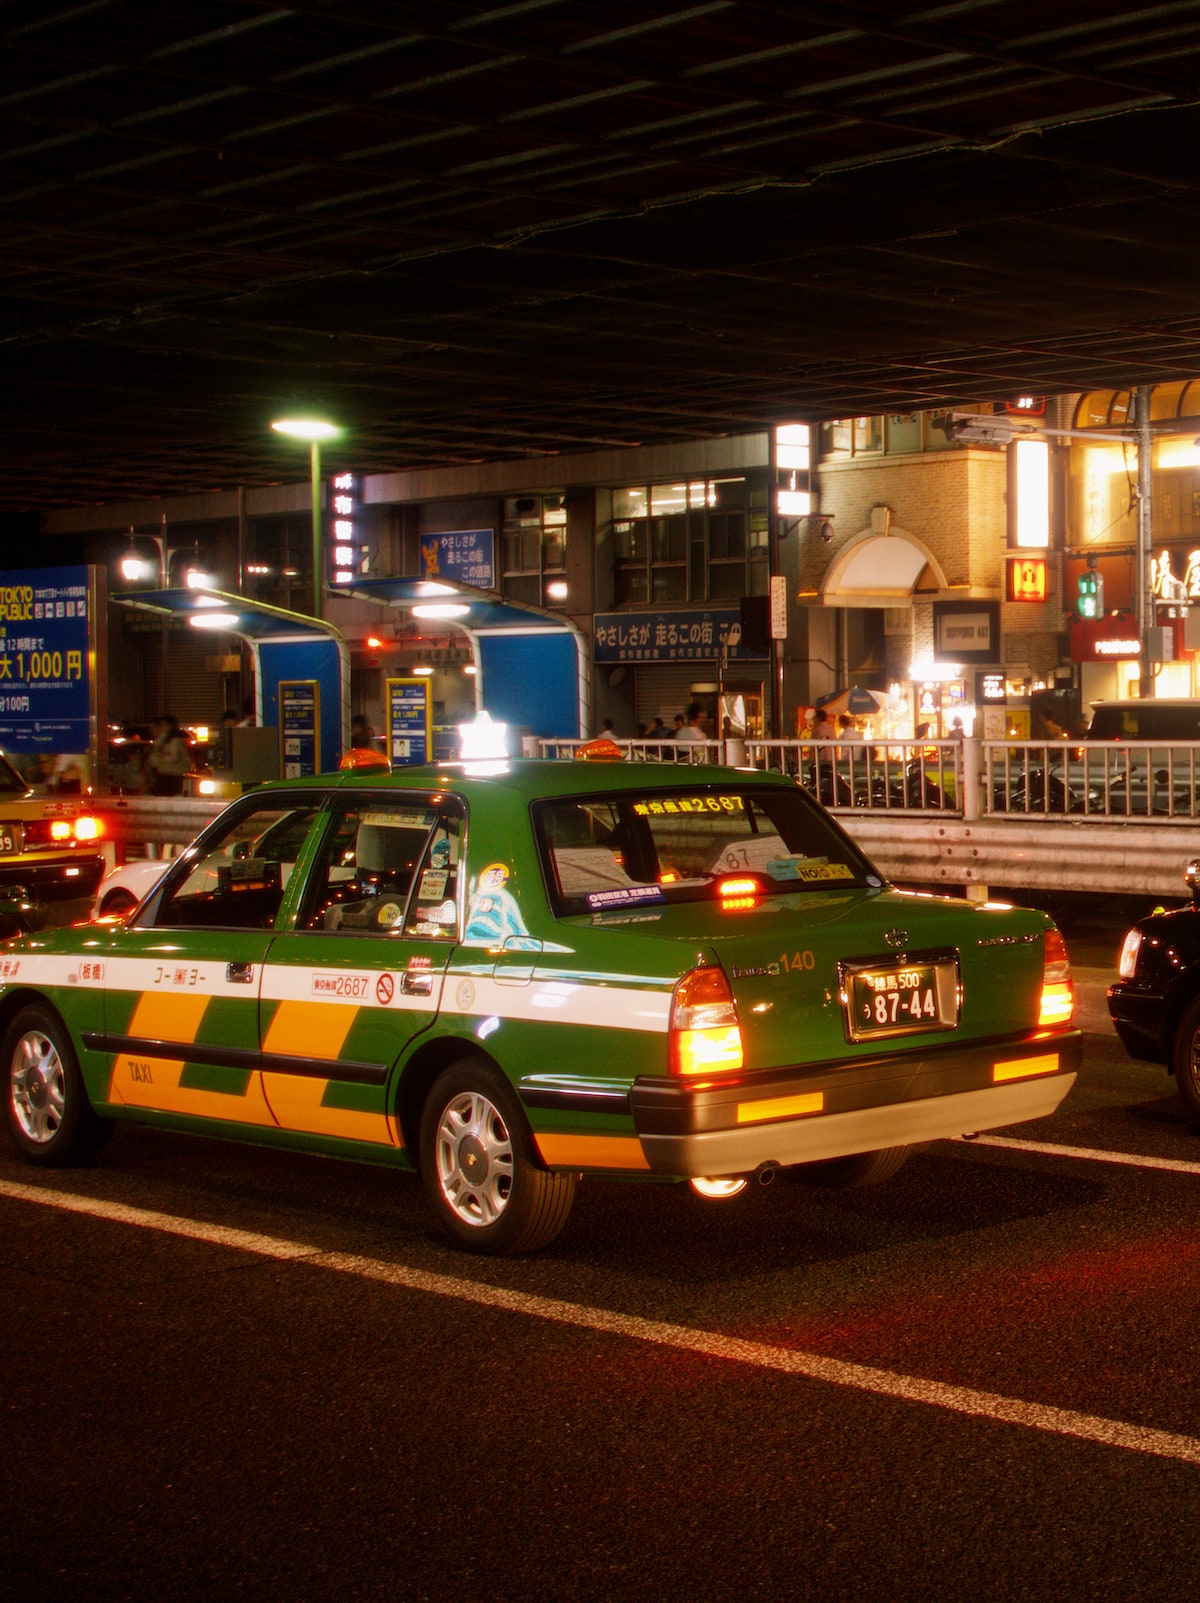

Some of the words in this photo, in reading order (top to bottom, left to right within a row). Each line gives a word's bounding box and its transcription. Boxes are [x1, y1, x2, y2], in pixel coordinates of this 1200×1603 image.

[440, 533, 477, 549] やさしさが
[0, 585, 33, 603] TOKYO
[0, 602, 33, 620] PUBLIC
[595, 623, 651, 647] やさしさが
[656, 621, 713, 646] 走るこの街
[780, 950, 815, 972] 140
[875, 976, 898, 992] 練馬
[899, 973, 919, 988] 500
[874, 988, 935, 1024] 87-44
[128, 1061, 153, 1084] TAXI
